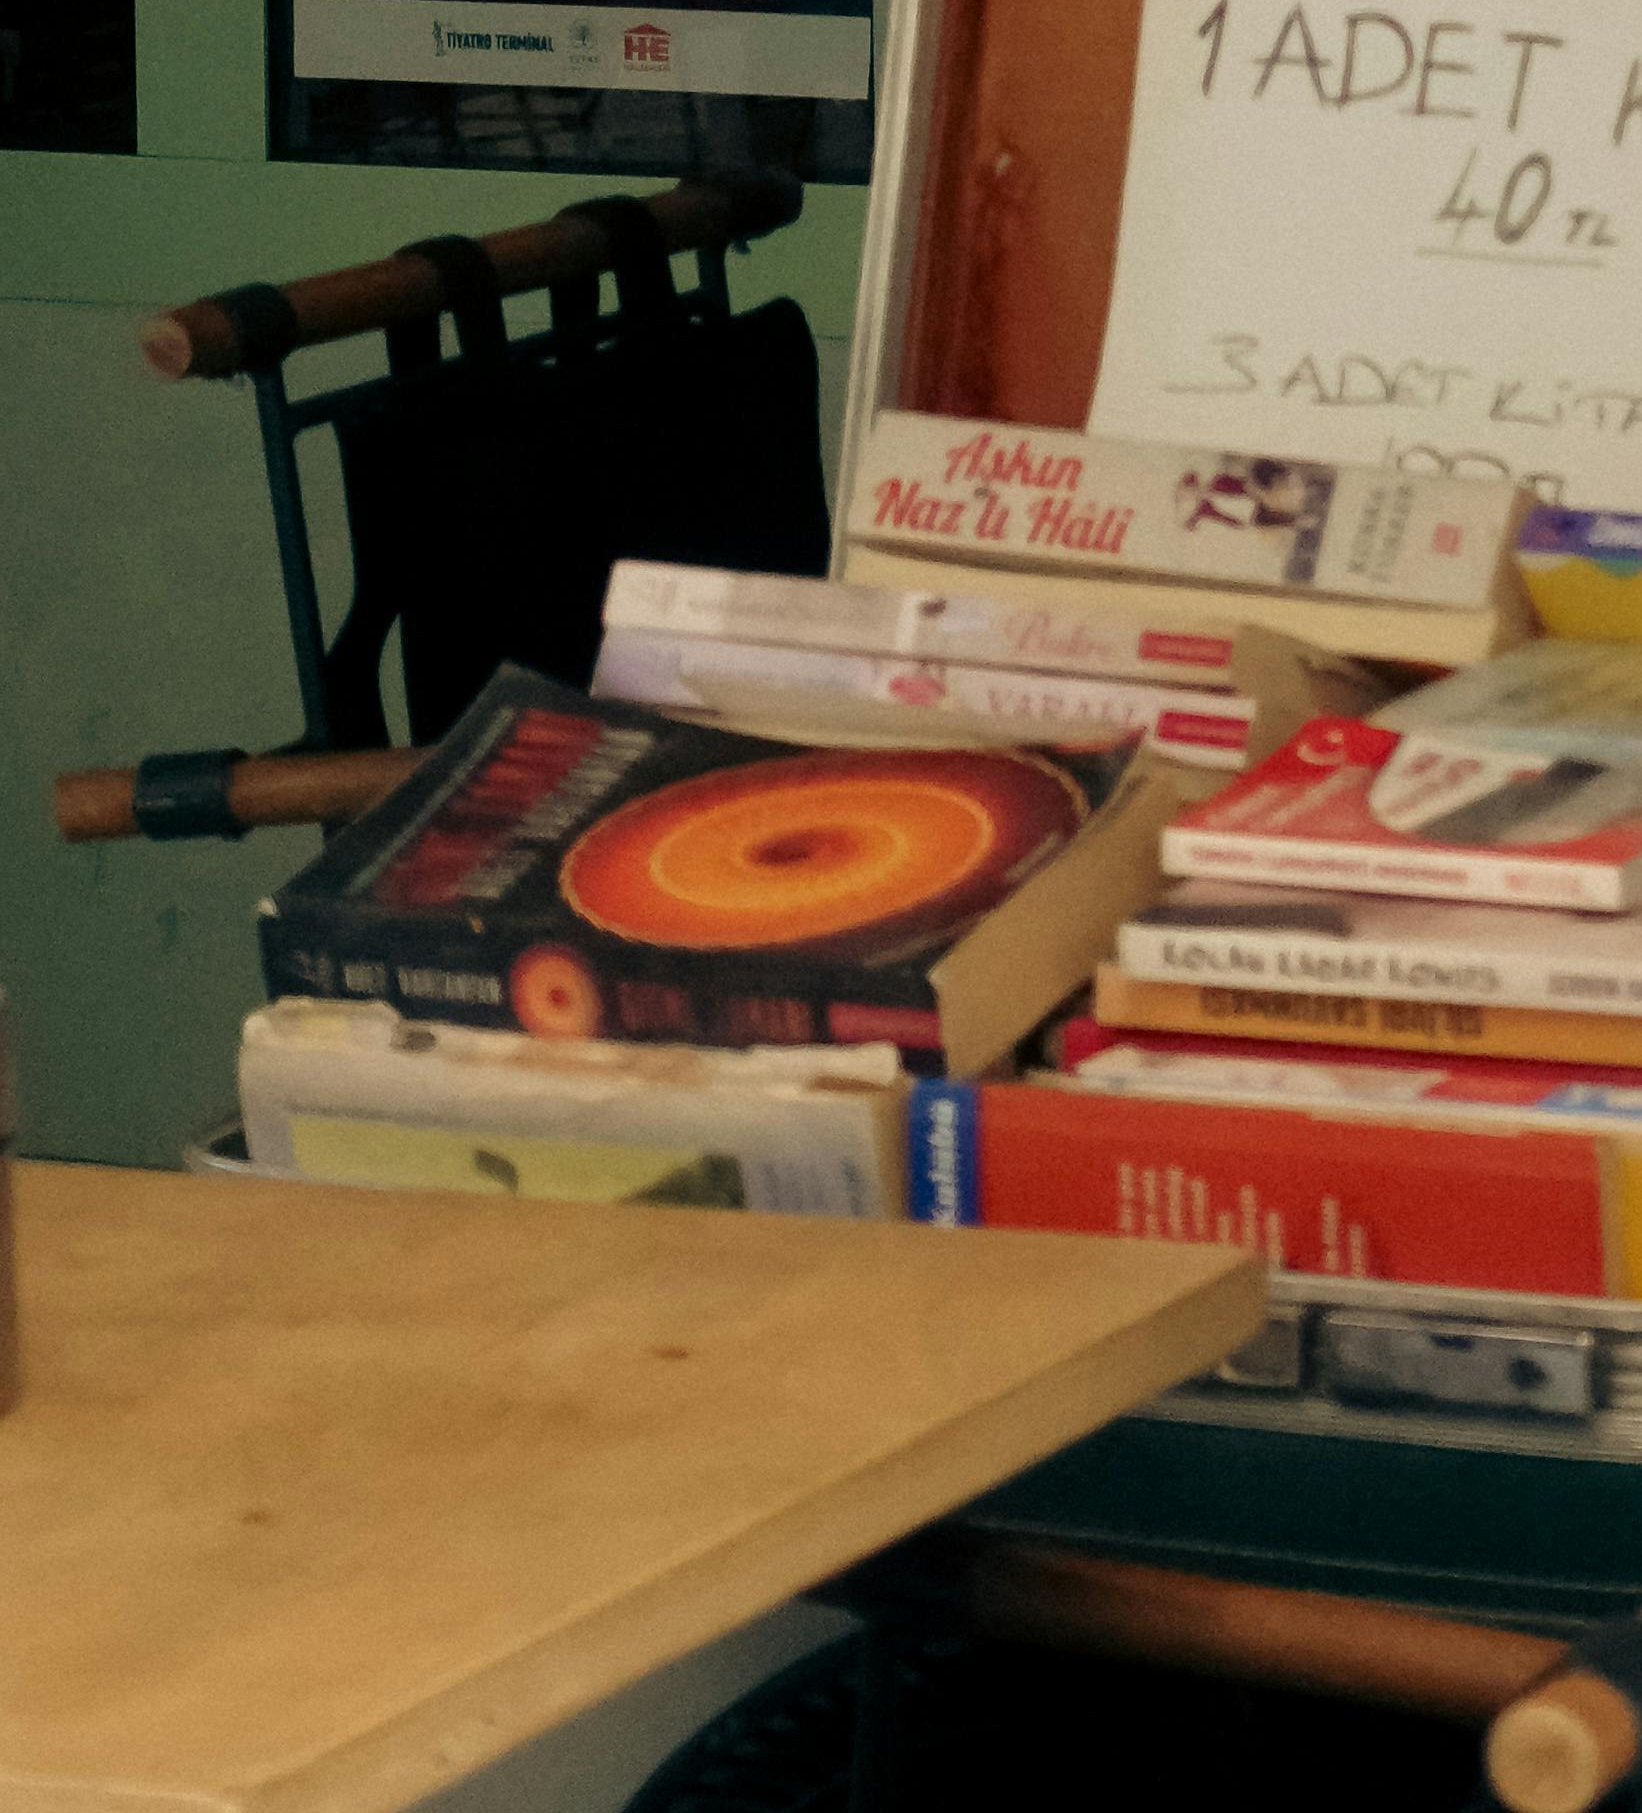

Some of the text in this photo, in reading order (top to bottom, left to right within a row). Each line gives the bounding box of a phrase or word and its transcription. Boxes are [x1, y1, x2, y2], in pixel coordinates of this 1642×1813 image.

[624, 34, 671, 62] HE
[1253, 1, 1564, 133] ADET
[1436, 147, 1552, 245] 40
[1281, 356, 1472, 408] ADET
